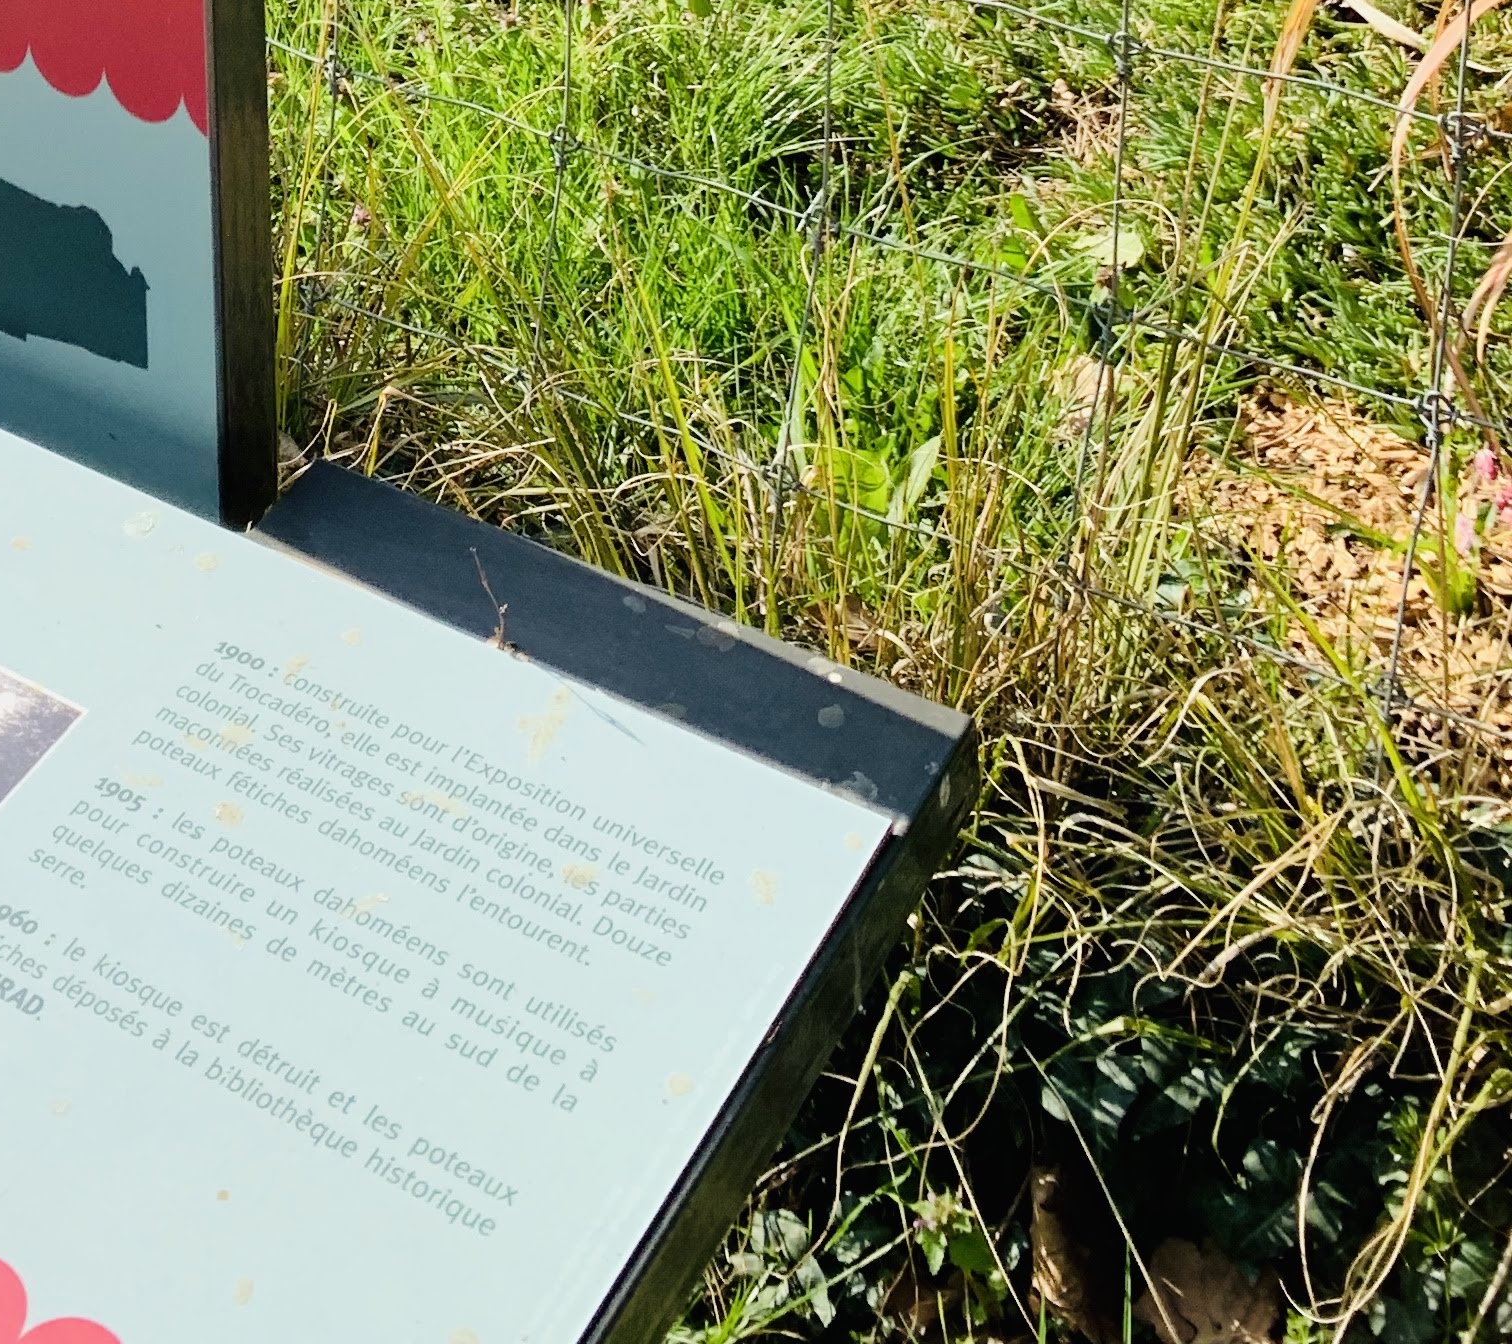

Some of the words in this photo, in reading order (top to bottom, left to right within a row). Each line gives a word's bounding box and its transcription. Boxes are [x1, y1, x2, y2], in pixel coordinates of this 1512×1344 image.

[27, 847, 86, 890] serre.
[130, 729, 224, 781] poteaux
[224, 770, 313, 825] fétiches
[317, 818, 452, 895] dahoméens
[154, 706, 275, 772] maçonnées
[275, 765, 377, 822] réalisées
[377, 815, 411, 839] au
[408, 827, 481, 874] Jardin
[485, 867, 584, 927] colonial.
[591, 914, 673, 968] Douze
[175, 684, 260, 734] colonial.
[262, 723, 305, 754] Ses
[307, 745, 396, 798] vitrages
[394, 790, 451, 825] sont
[599, 888, 692, 940] parties
[194, 661, 225, 684] du
[228, 672, 346, 740] Trocadéro,
[339, 731, 381, 758] elle
[384, 751, 424, 778] est
[422, 765, 539, 833] implantée
[542, 824, 603, 863] dans
[606, 850, 632, 877] le
[631, 864, 709, 914] Jardin
[213, 641, 267, 671] 1900
[284, 672, 391, 730] construite
[389, 722, 450, 756] pour
[592, 815, 726, 886] universelle
[51, 824, 154, 886] quelques
[160, 880, 258, 941] dizaines
[265, 935, 298, 963] de
[305, 958, 394, 1014] mètres
[400, 1010, 438, 1038] au
[443, 1032, 500, 1069] sud
[505, 1063, 542, 1093] de
[550, 1082, 579, 1114] la
[67, 799, 131, 835] pour
[135, 833, 257, 903] construire
[265, 899, 299, 926] un
[307, 917, 411, 985] kiosque
[420, 976, 441, 1001] à
[449, 995, 568, 1066] musique
[578, 1057, 599, 1084] à
[93, 776, 148, 813] 1905
[170, 811, 207, 841] les
[207, 836, 307, 894] poteaux
[312, 887, 451, 967] dahoméens
[456, 962, 516, 1002] sont
[524, 995, 618, 1054] utilisés
[51, 973, 149, 1038] déposés
[151, 1027, 172, 1052] à
[173, 1039, 200, 1069] la
[203, 1056, 359, 1159] bibliothèque
[363, 1146, 497, 1237] historique
[61, 936, 87, 963] le
[91, 953, 184, 1018] kiosque
[189, 1013, 232, 1045] est
[236, 1037, 321, 1096] détruit
[326, 1090, 358, 1116] et
[361, 1103, 404, 1141] les
[406, 1136, 520, 1208] poteaux
